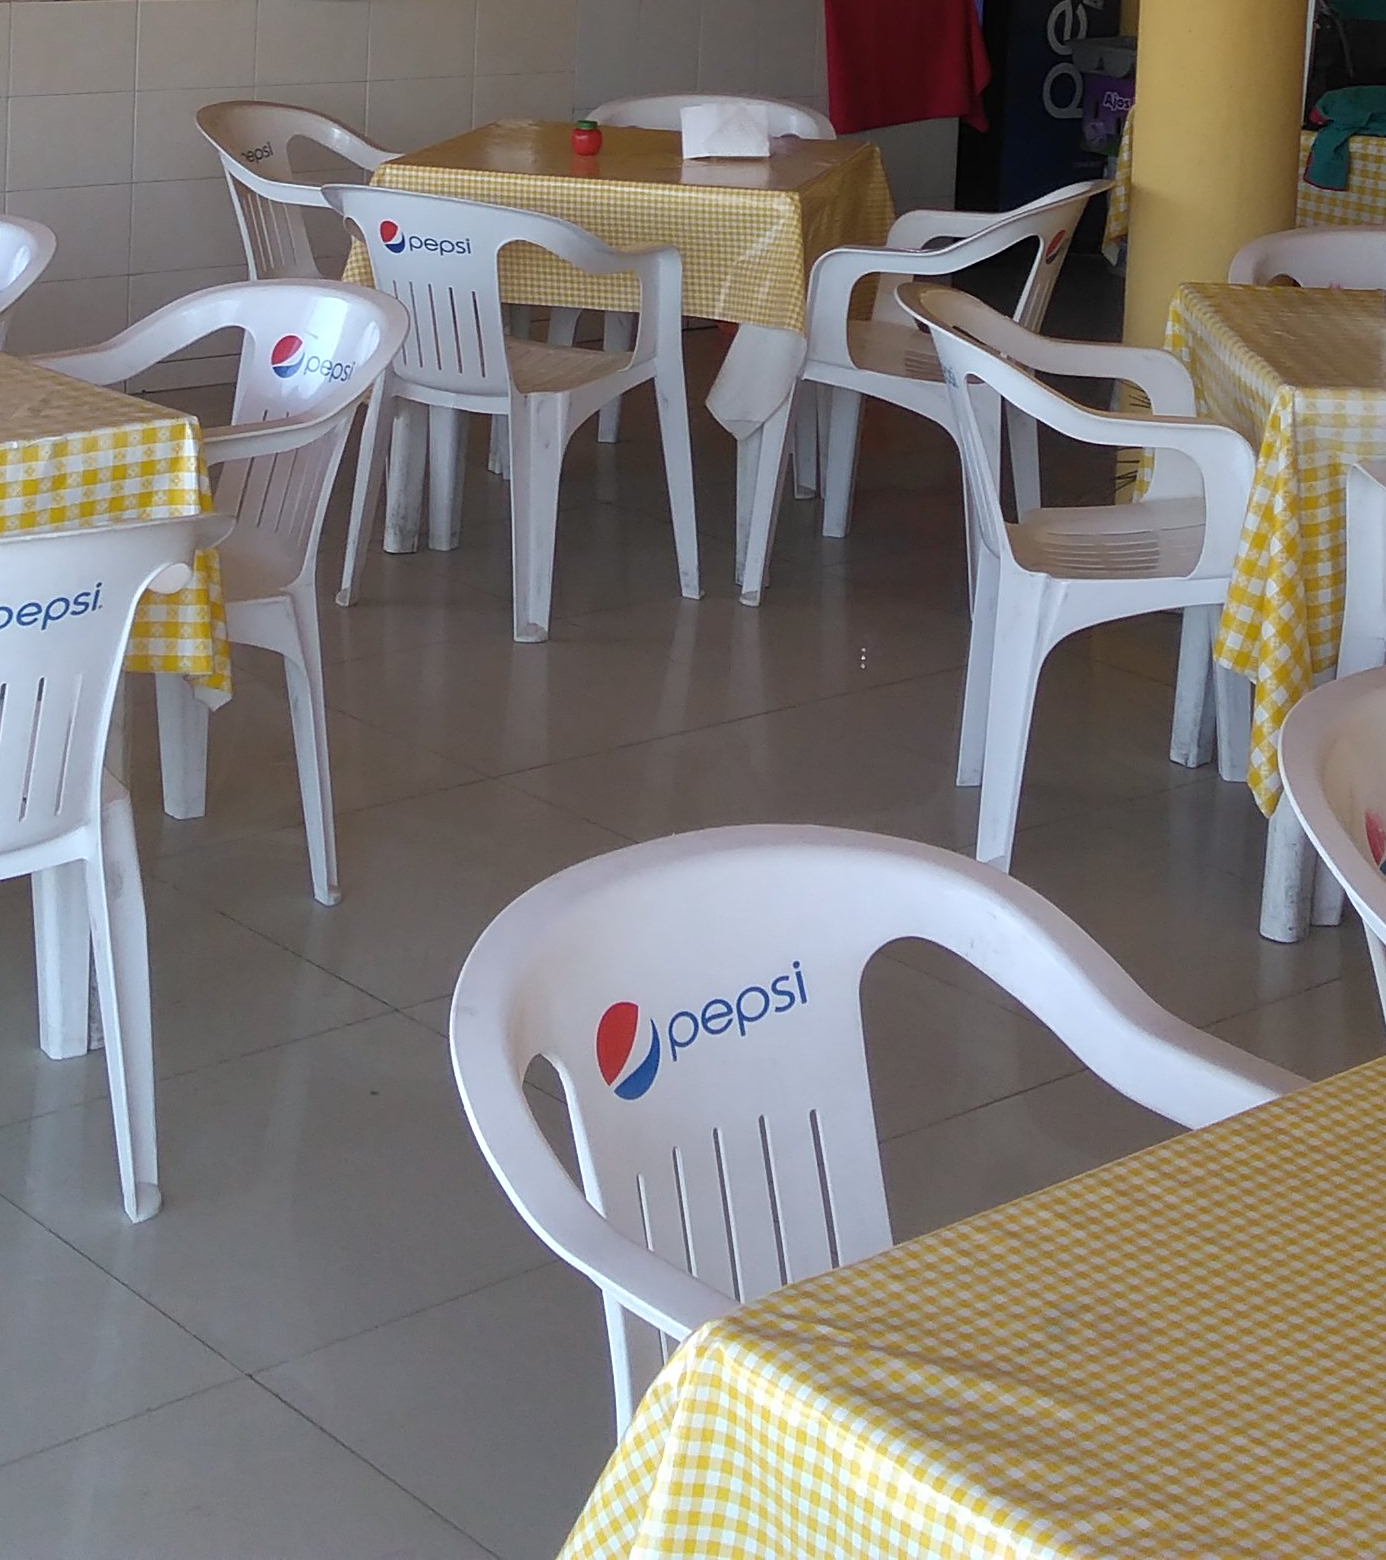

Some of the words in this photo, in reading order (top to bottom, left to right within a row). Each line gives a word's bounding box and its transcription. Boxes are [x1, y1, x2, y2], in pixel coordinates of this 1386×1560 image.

[409, 236, 472, 256] pepsi
[304, 355, 356, 382] pepsi
[668, 960, 807, 1062] pepsi
